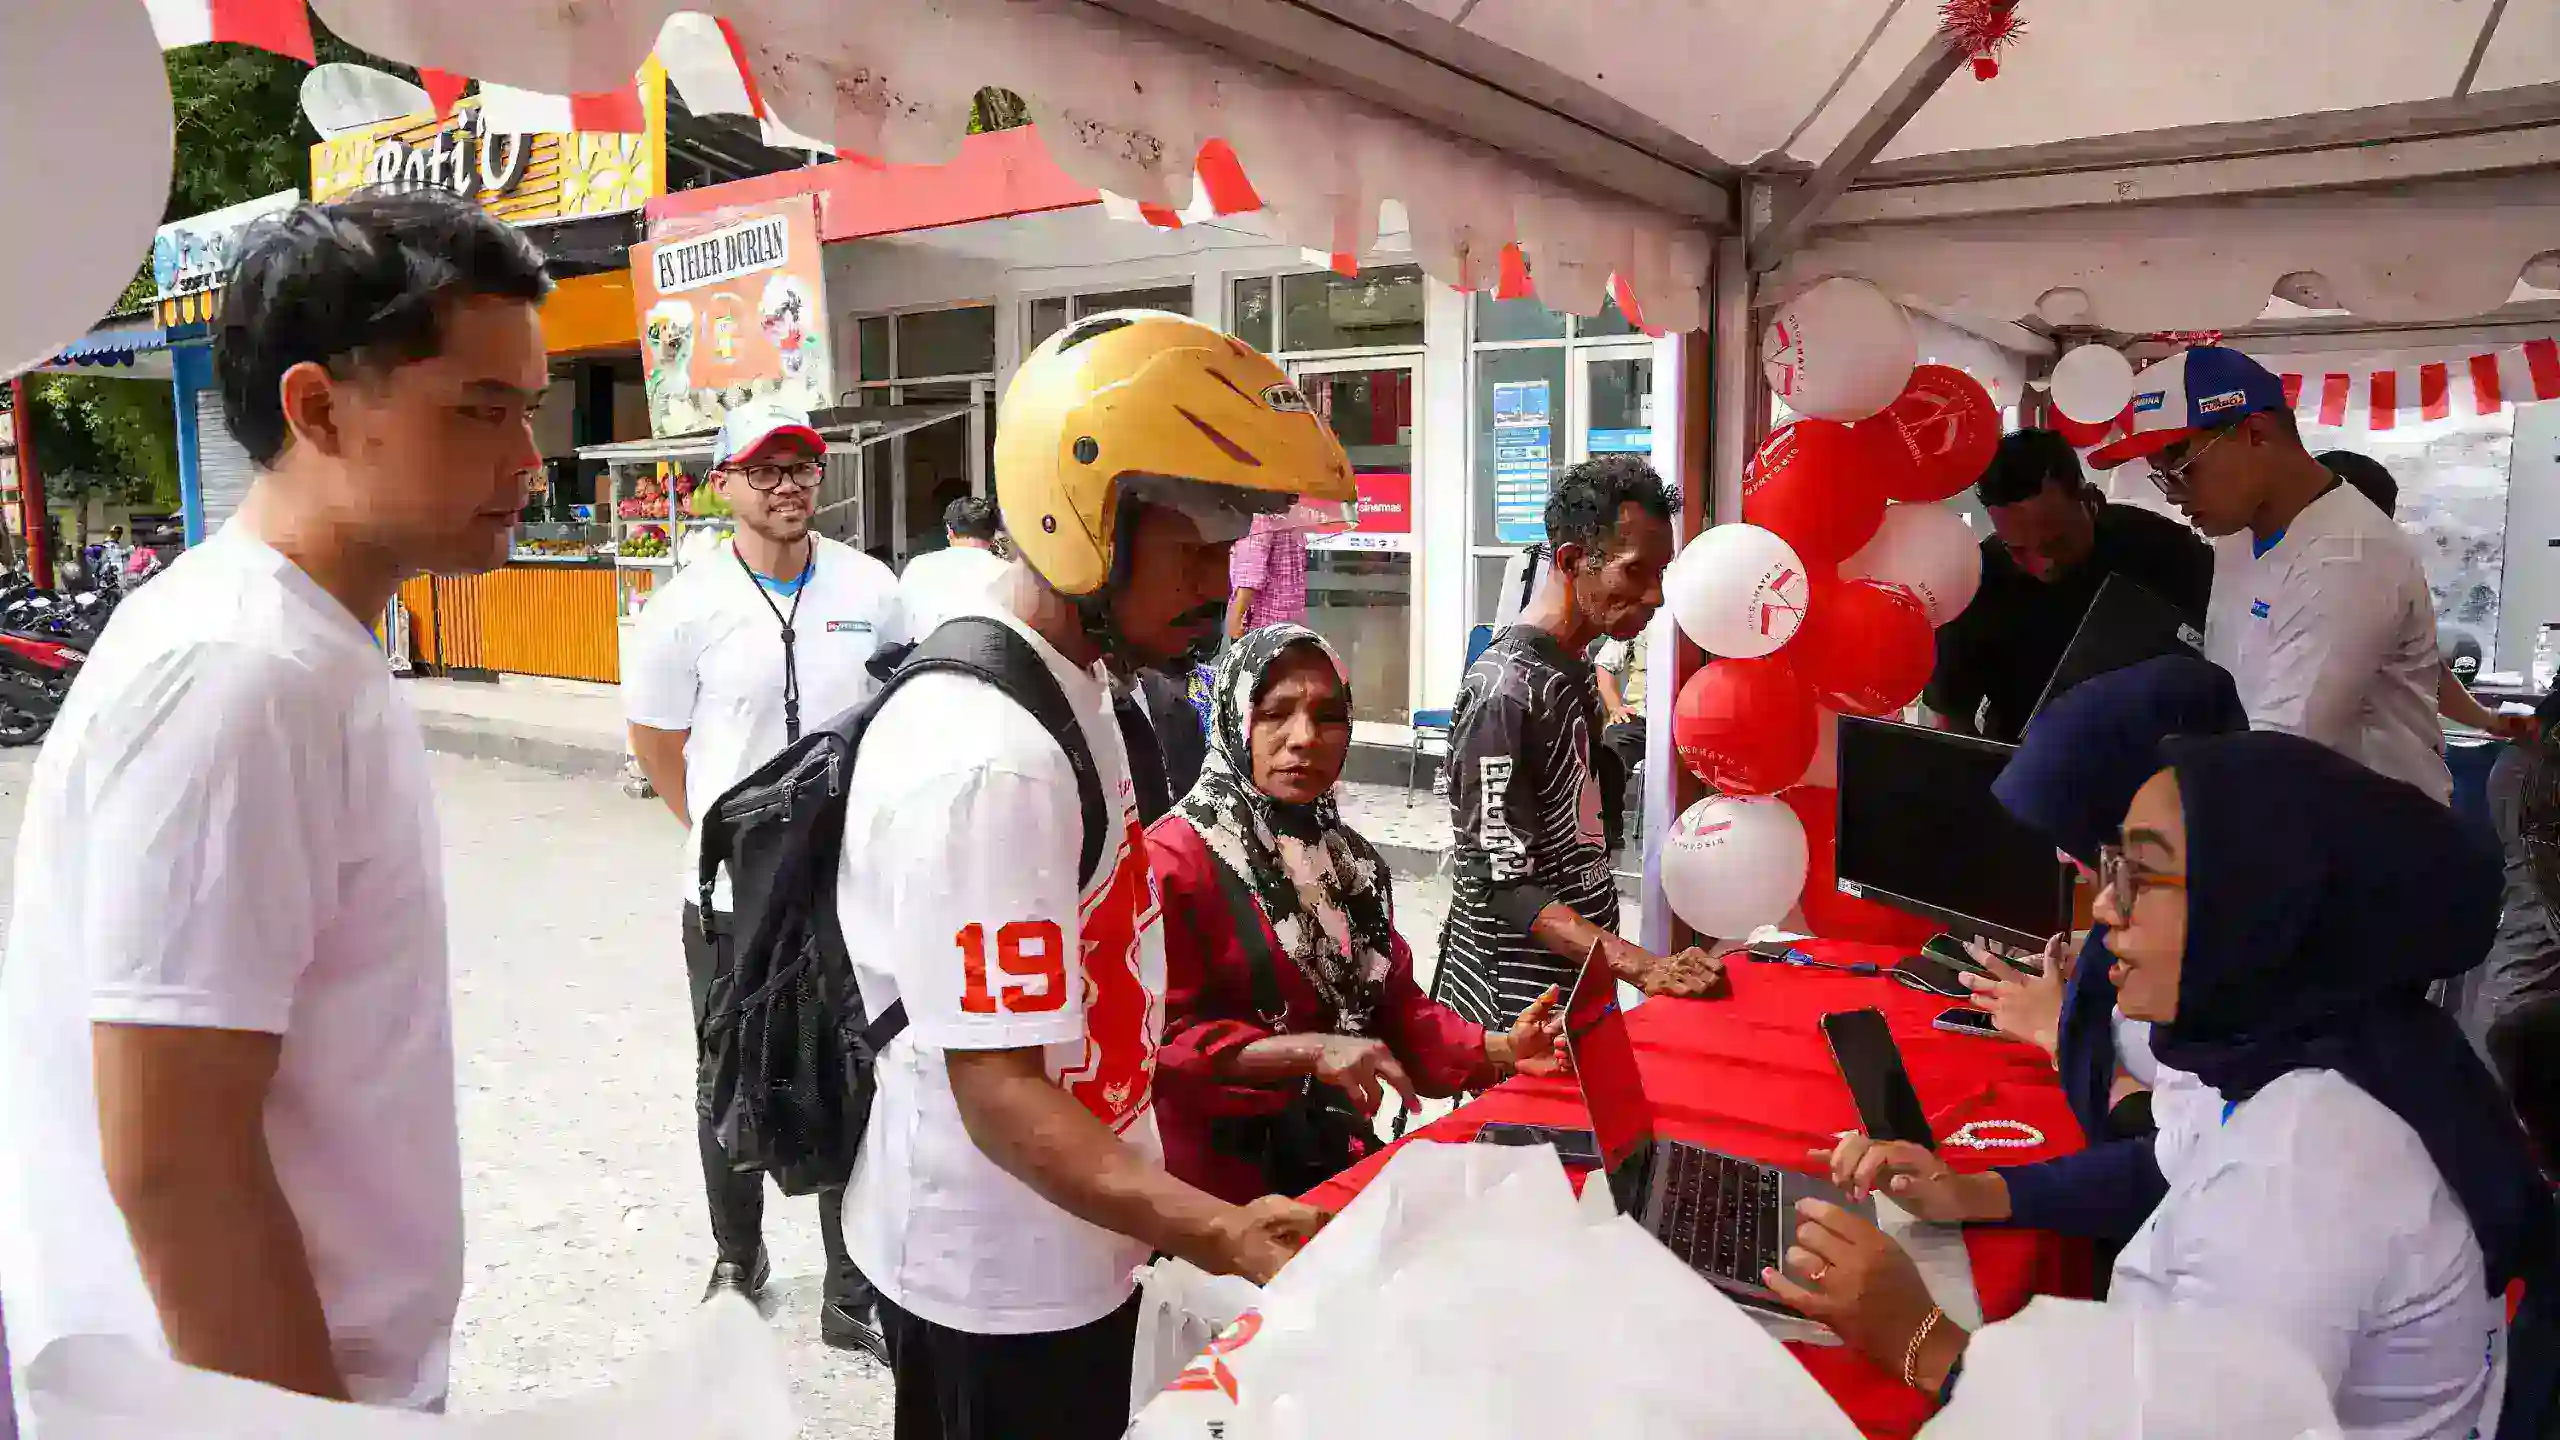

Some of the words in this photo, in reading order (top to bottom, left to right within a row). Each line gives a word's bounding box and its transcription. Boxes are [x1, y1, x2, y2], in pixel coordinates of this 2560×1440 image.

[658, 252, 675, 288] ES
[677, 239, 722, 283] TELER
[725, 221, 784, 271] DURIAN
[956, 921, 1067, 1014] 19
